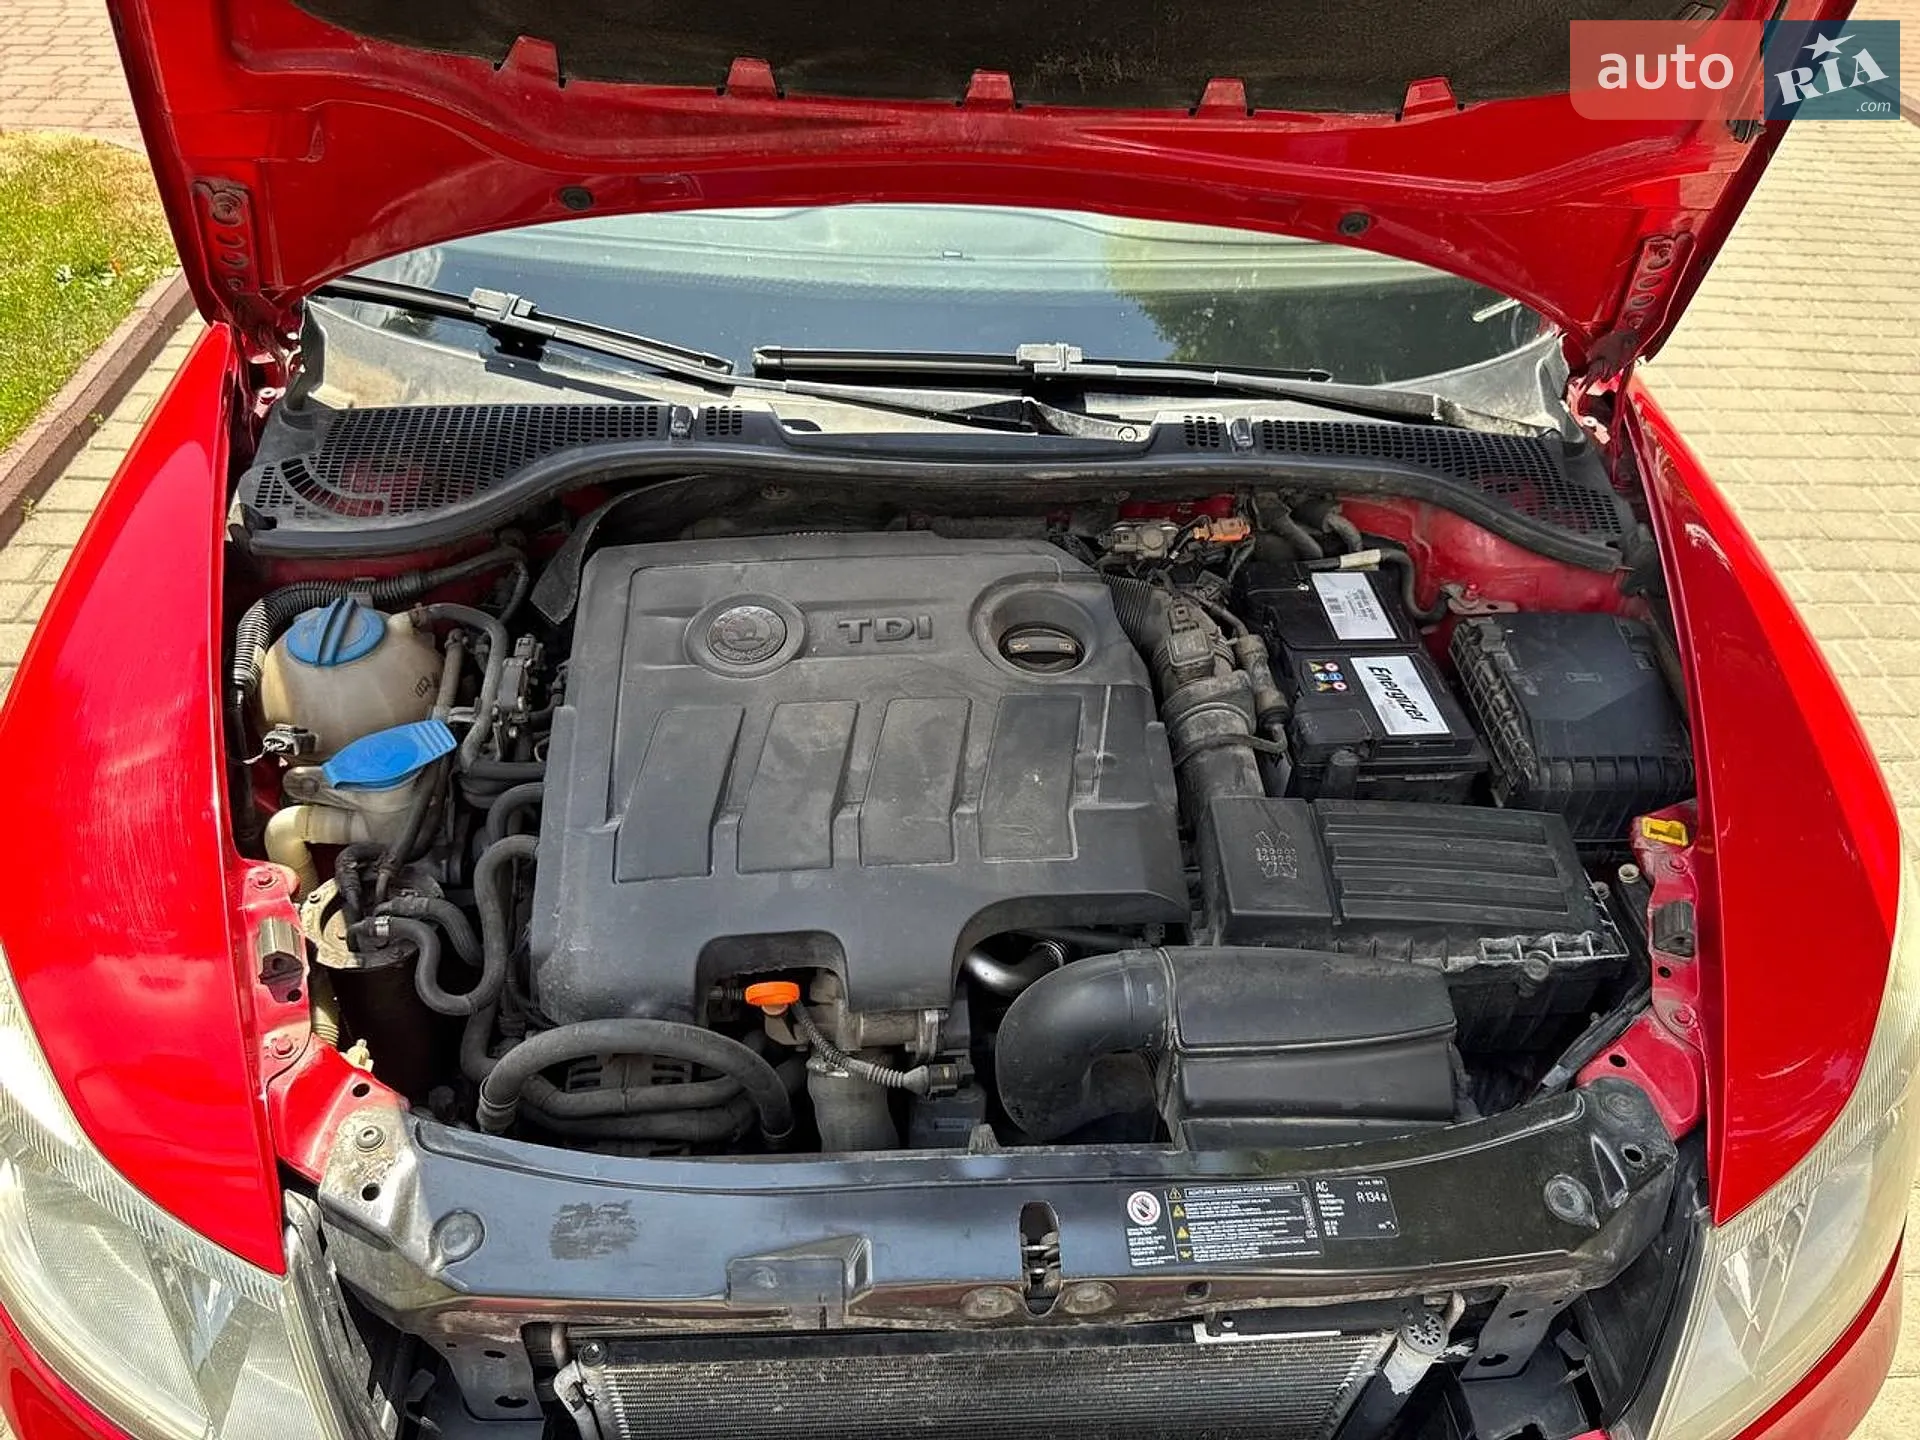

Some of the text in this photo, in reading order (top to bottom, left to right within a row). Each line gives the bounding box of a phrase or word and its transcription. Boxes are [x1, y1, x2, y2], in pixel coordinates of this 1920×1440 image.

[838, 616, 932, 643] TDI
[1367, 666, 1429, 722] Energizer
[1315, 1181, 1329, 1193] AC
